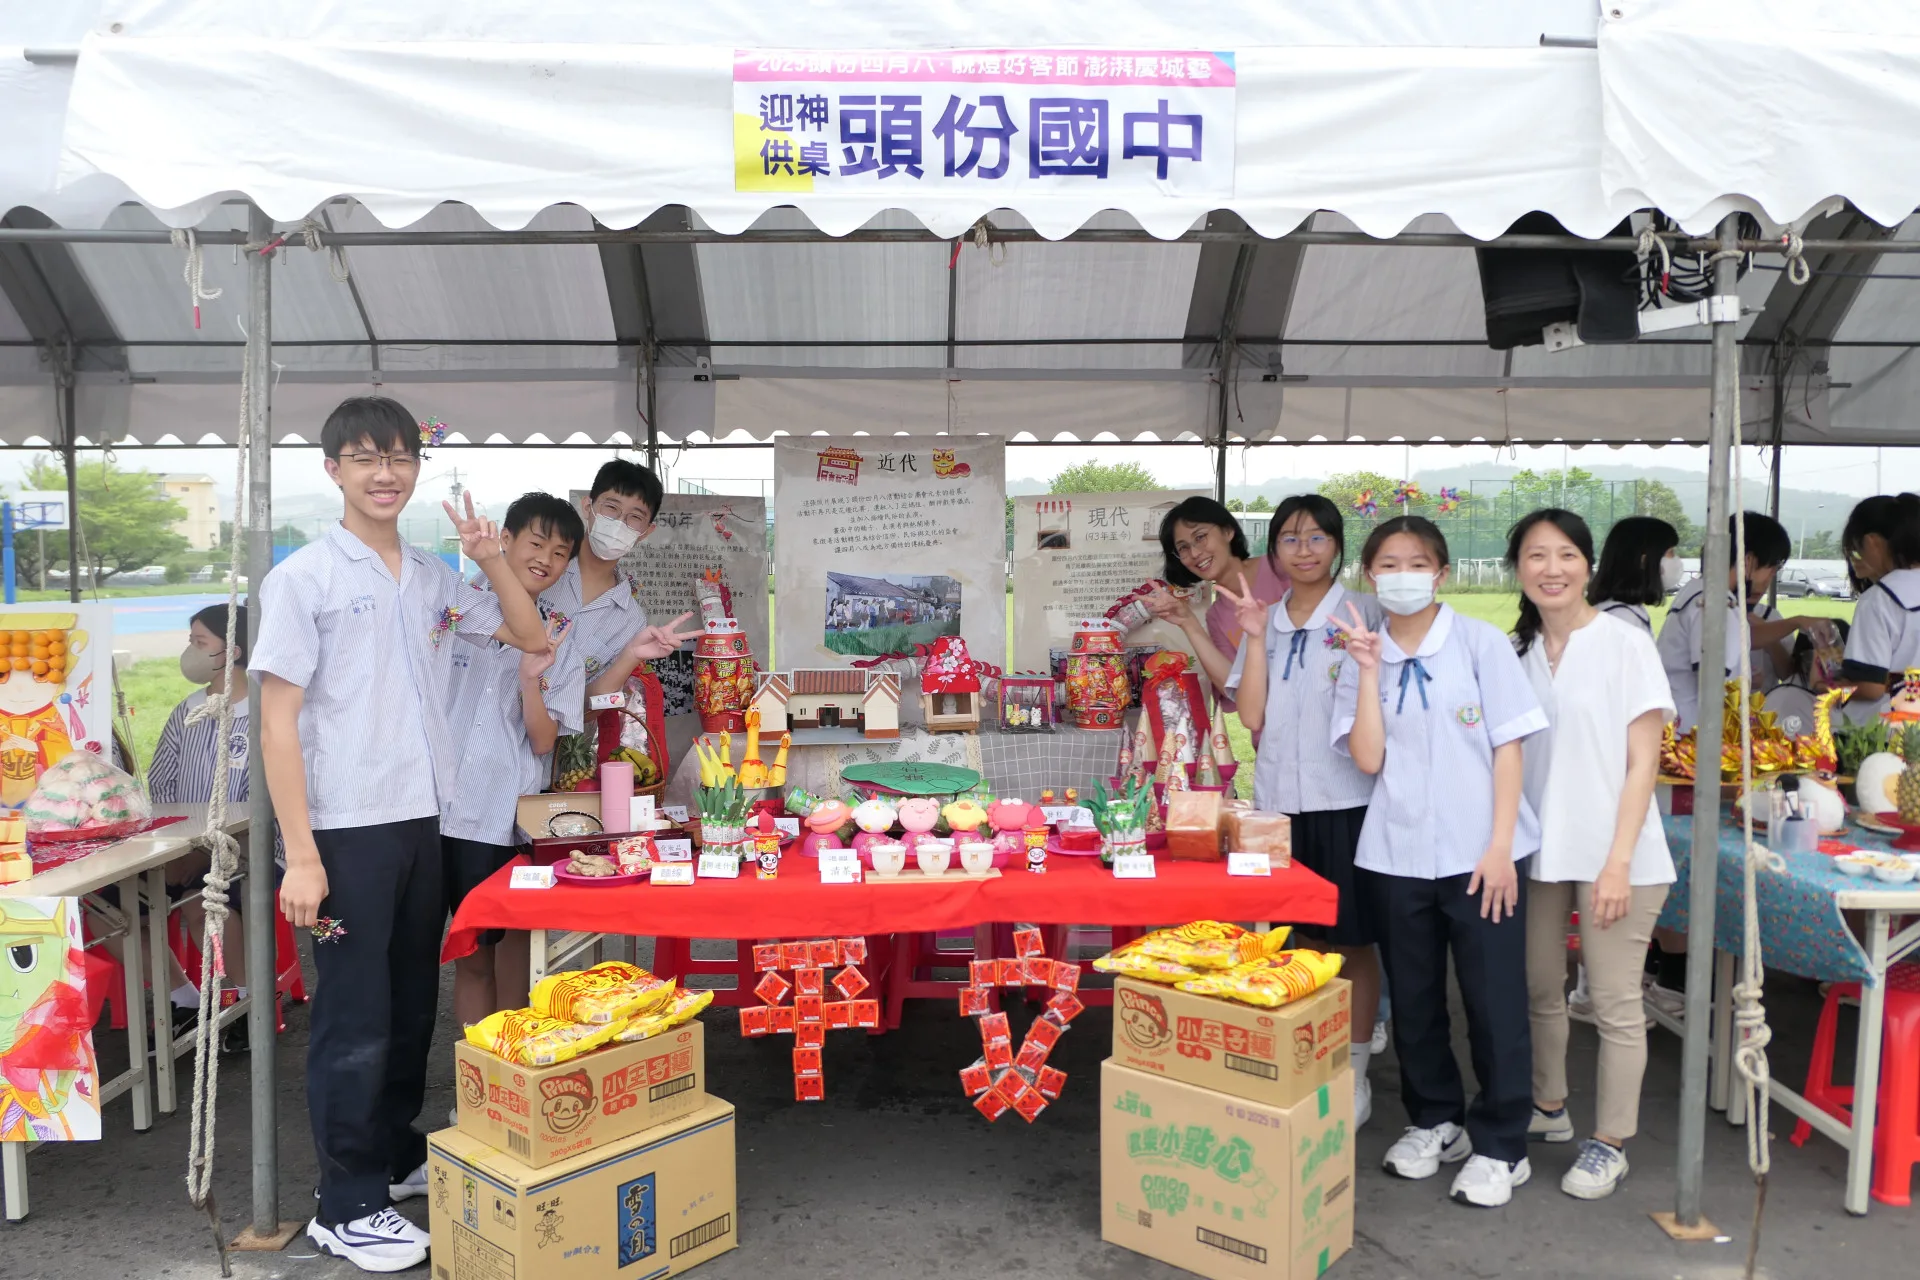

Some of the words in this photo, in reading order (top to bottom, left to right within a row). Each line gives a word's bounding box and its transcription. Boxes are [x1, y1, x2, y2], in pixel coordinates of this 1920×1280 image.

[759, 94, 830, 132] 迎神
[838, 94, 1204, 180] 頭份國中
[759, 139, 831, 177] 供桌
[877, 453, 918, 473] 近代
[1088, 506, 1130, 527] 現代
[1120, 989, 1163, 1021] Prince
[1177, 1016, 1277, 1060] 小王子麵
[540, 1079, 589, 1100] Prince
[602, 1046, 694, 1103] 小王子麵
[488, 1083, 531, 1119] 小王子麵
